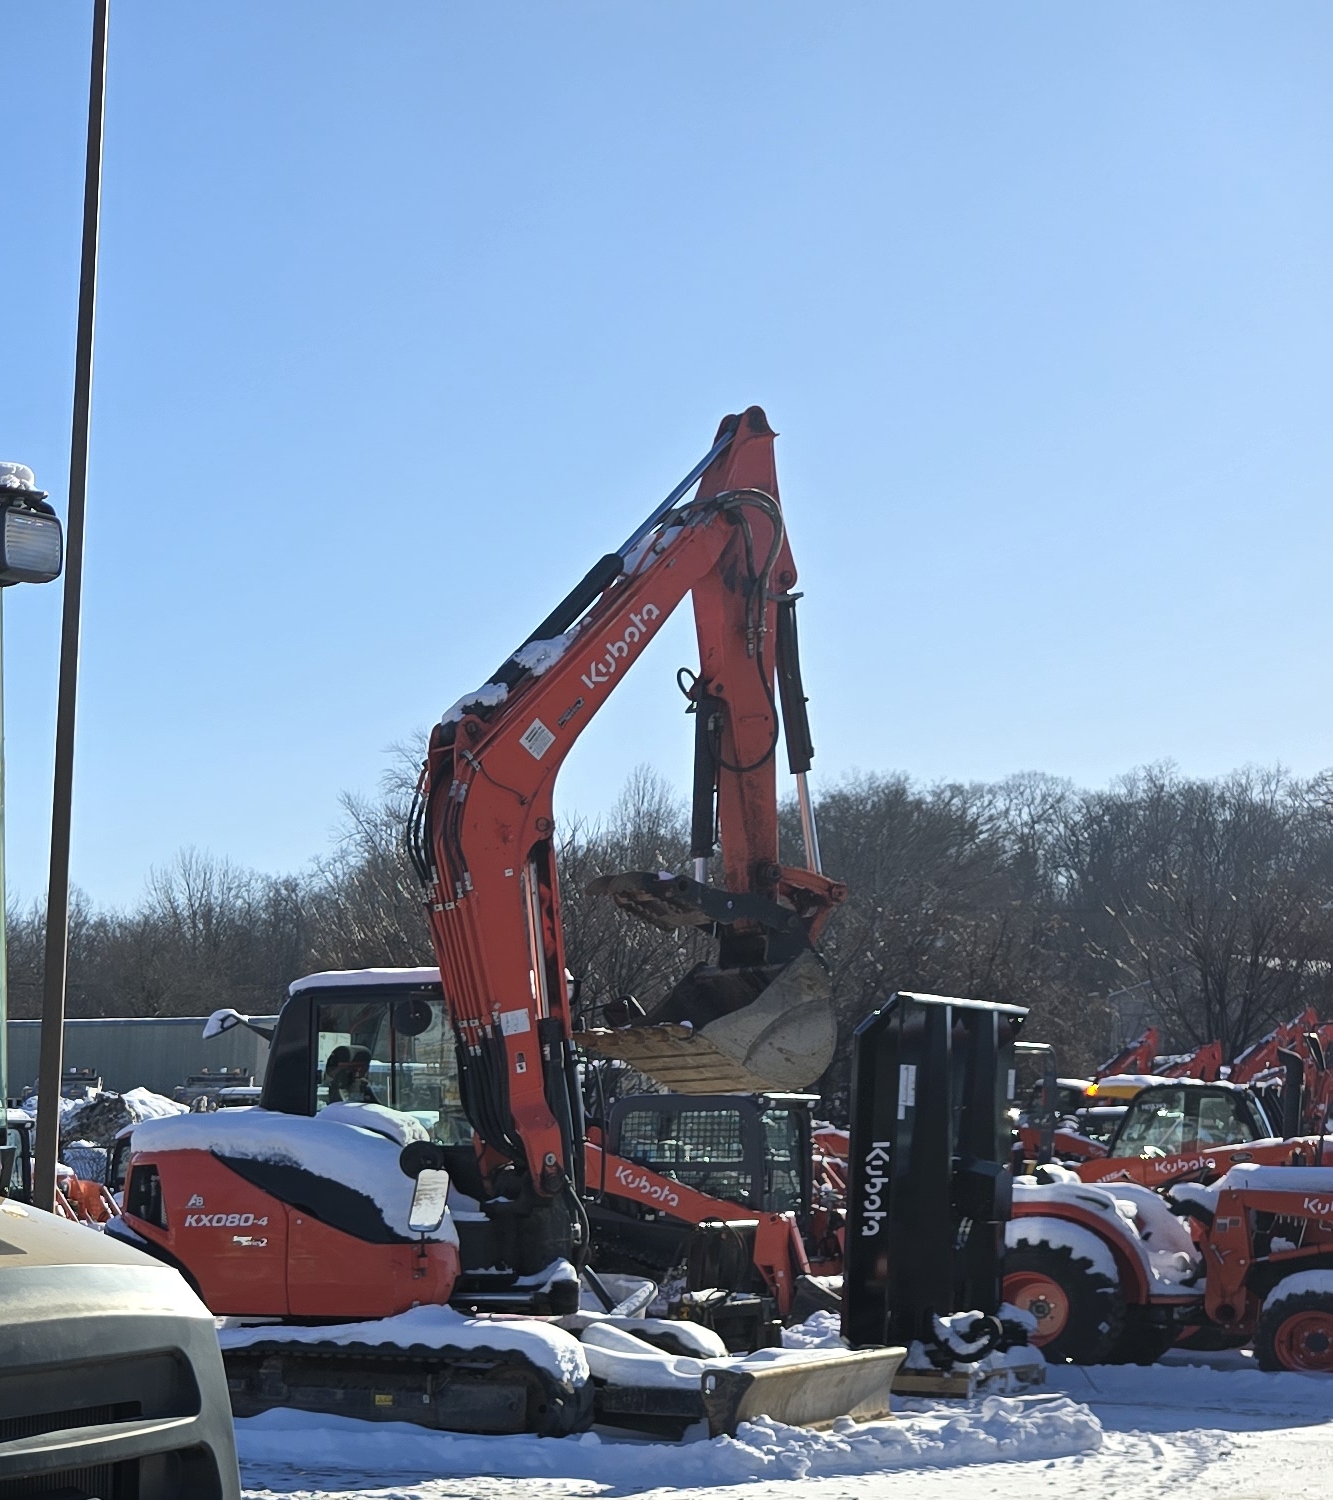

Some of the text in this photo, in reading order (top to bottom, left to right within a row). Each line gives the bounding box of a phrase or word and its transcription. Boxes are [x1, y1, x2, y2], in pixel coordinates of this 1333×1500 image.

[581, 603, 660, 689] Kubota
[1155, 1155, 1216, 1174] Kubota
[615, 1165, 679, 1207] Kubota
[861, 1141, 891, 1236] Kubota
[184, 1213, 269, 1227] KX080-4
